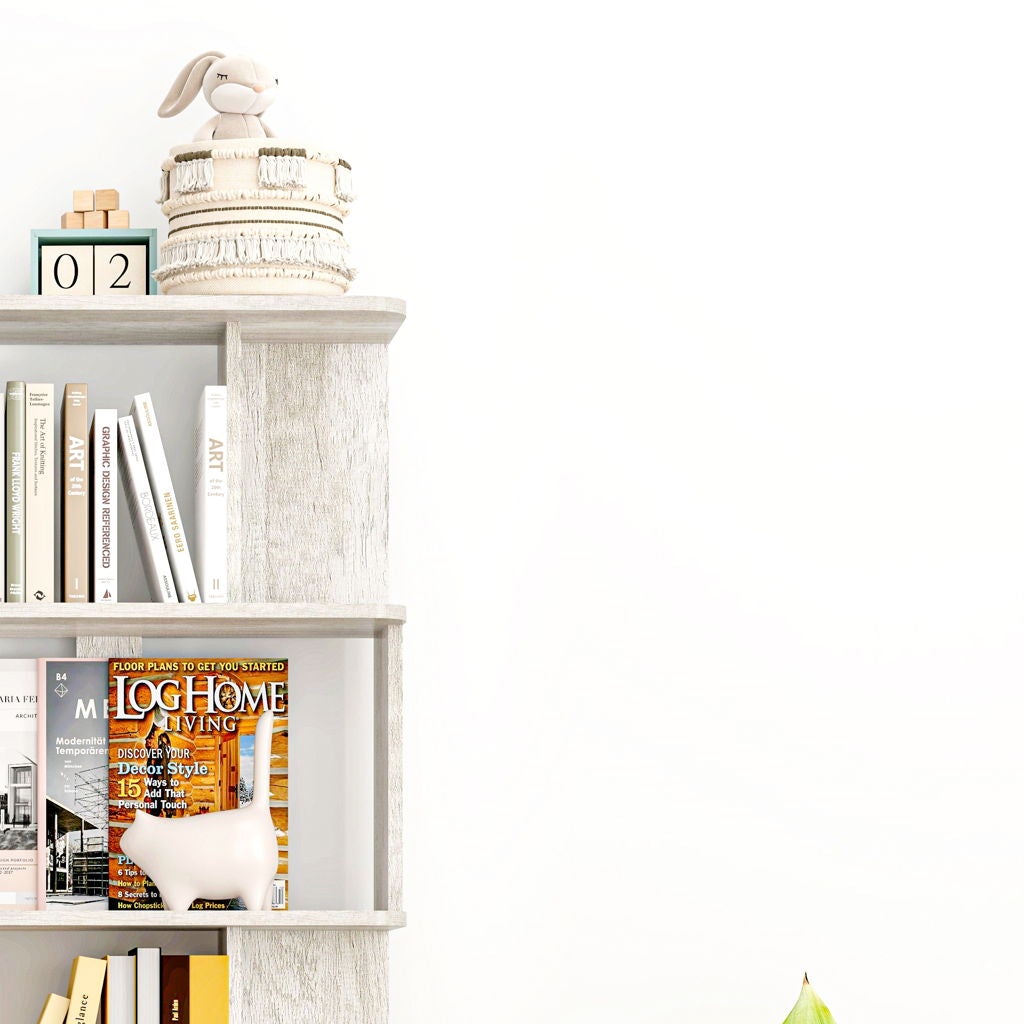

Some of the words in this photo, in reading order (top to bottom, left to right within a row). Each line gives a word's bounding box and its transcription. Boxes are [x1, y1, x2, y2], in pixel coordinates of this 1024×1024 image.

[109, 253, 131, 288] 2
[69, 436, 84, 472] ART
[102, 427, 110, 468] GRAPHIC
[208, 438, 224, 472] ART
[12, 452, 21, 479] FRANK
[38, 449, 46, 475] Knitting
[102, 470, 110, 504] DESIGN
[12, 504, 21, 534] WRIGHT
[140, 491, 160, 541] BORDEAUX
[163, 492, 180, 531] SAARINEN
[102, 508, 110, 568] REFERENCED
[174, 533, 184, 553] EERO
[113, 662, 144, 671] FLOOR
[148, 662, 179, 671] PLANS
[182, 662, 194, 671] TO
[197, 662, 216, 671] GET
[219, 662, 238, 671] YOU
[242, 662, 285, 671] STARTED
[165, 715, 236, 732] LIVING
[118, 748, 162, 759] DISCOVER
[165, 748, 190, 759] YOUR
[118, 762, 163, 775] Decor
[167, 761, 208, 778] Style
[117, 779, 141, 798] 15
[144, 778, 167, 788] Ways
[171, 778, 179, 786] to
[144, 789, 162, 798] Add
[165, 789, 185, 798] That
[118, 800, 158, 809] Personal
[161, 800, 187, 809] Touch
[125, 869, 138, 877] Tips
[191, 902, 204, 910] Log
